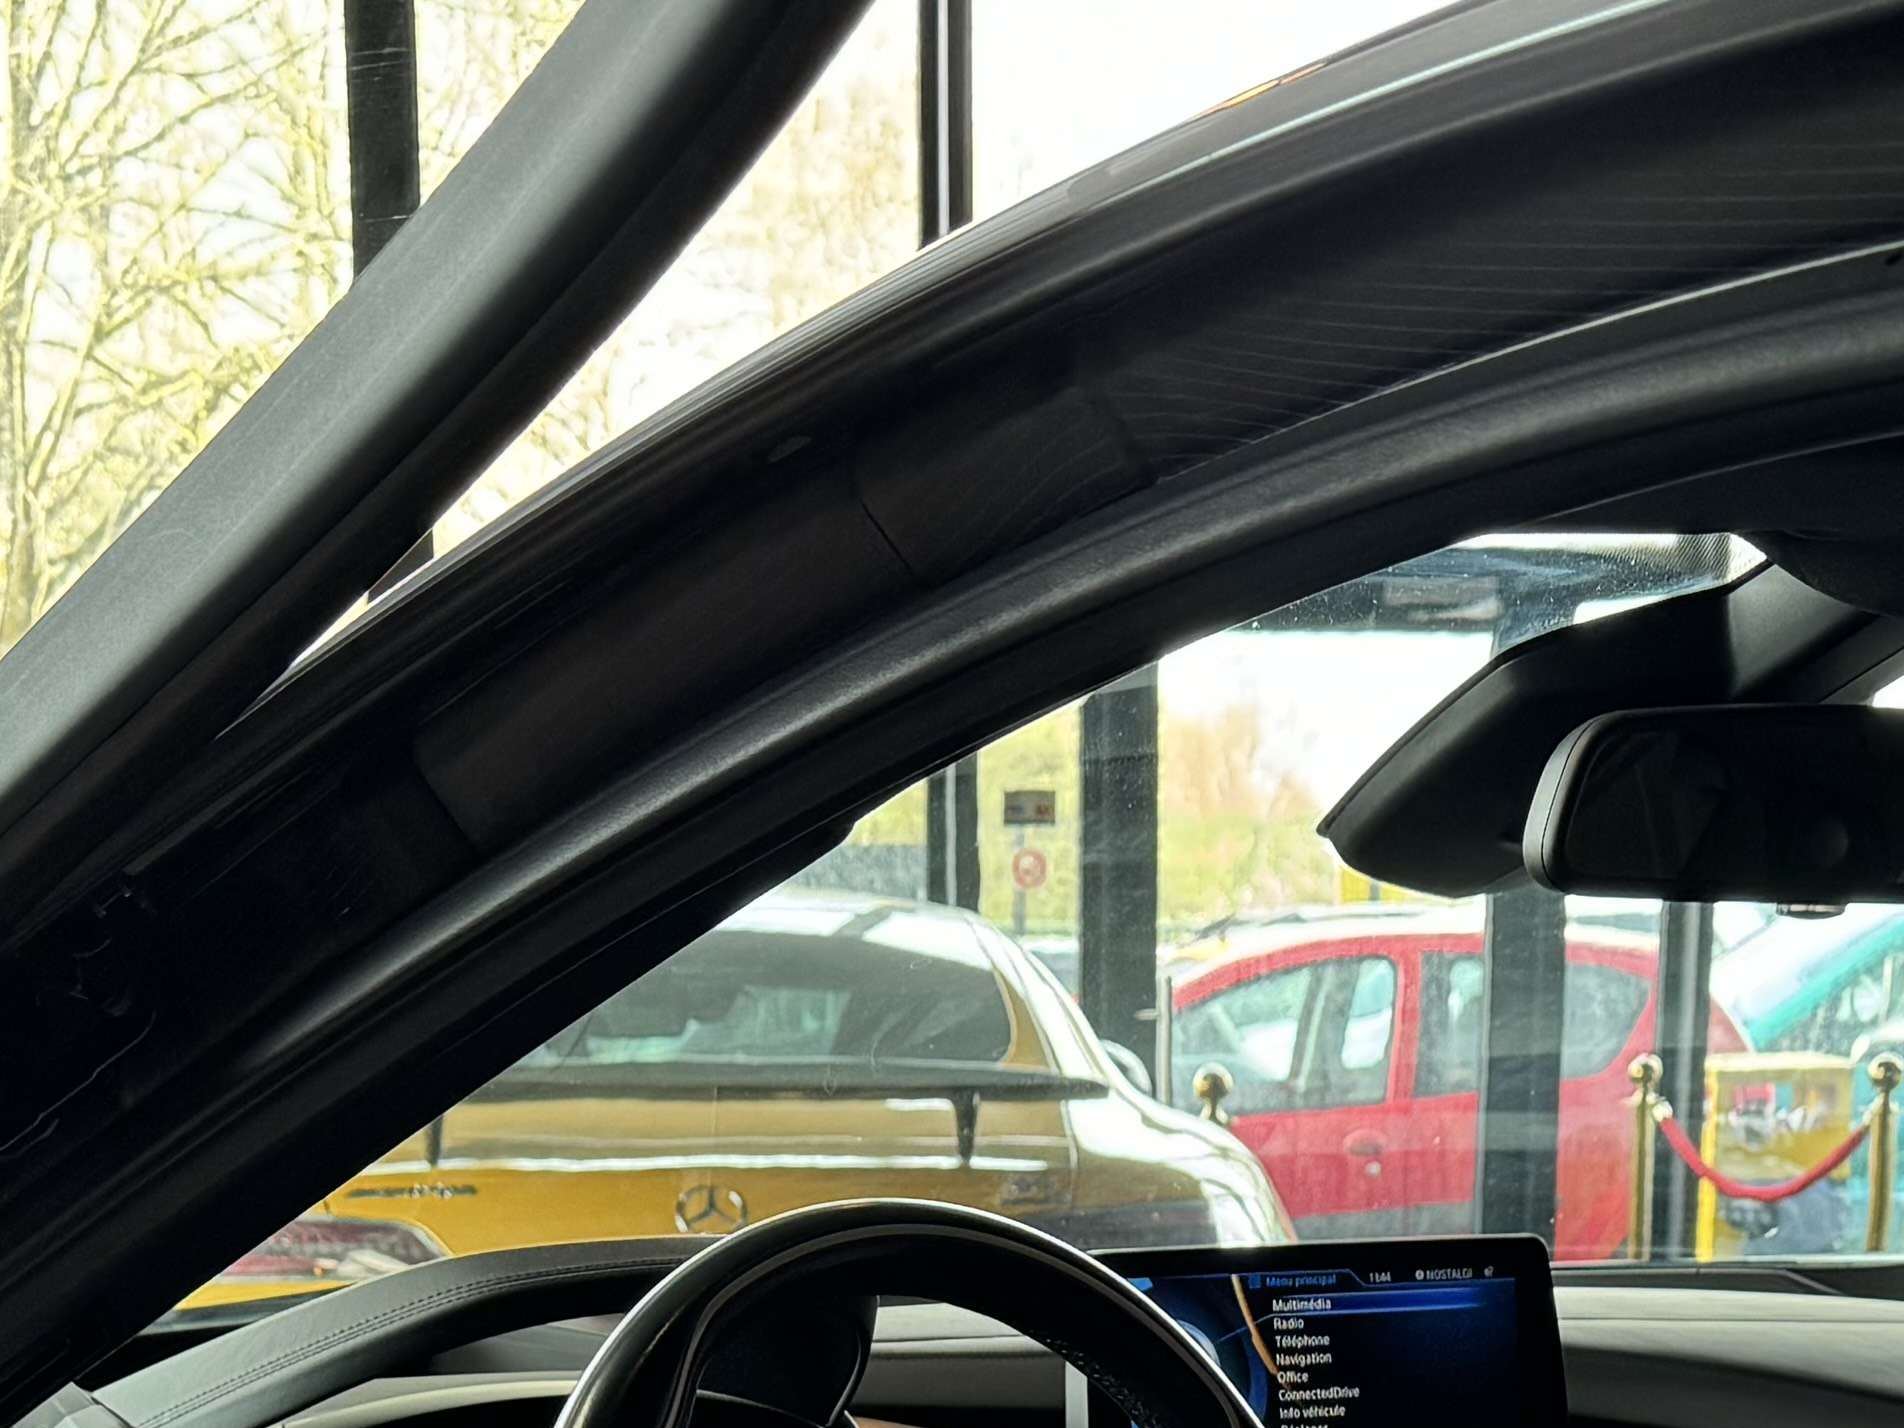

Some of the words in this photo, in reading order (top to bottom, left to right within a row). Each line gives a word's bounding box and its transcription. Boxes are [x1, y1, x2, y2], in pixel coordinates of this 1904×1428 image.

[1272, 1298, 1332, 1312] Multimédia
[1273, 1317, 1305, 1330] Radio
[1275, 1334, 1330, 1349] Téléphone
[1276, 1352, 1333, 1367] Navigation
[1277, 1371, 1309, 1383] Office
[1279, 1407, 1301, 1419] Info
[1302, 1404, 1346, 1418] véhicule
